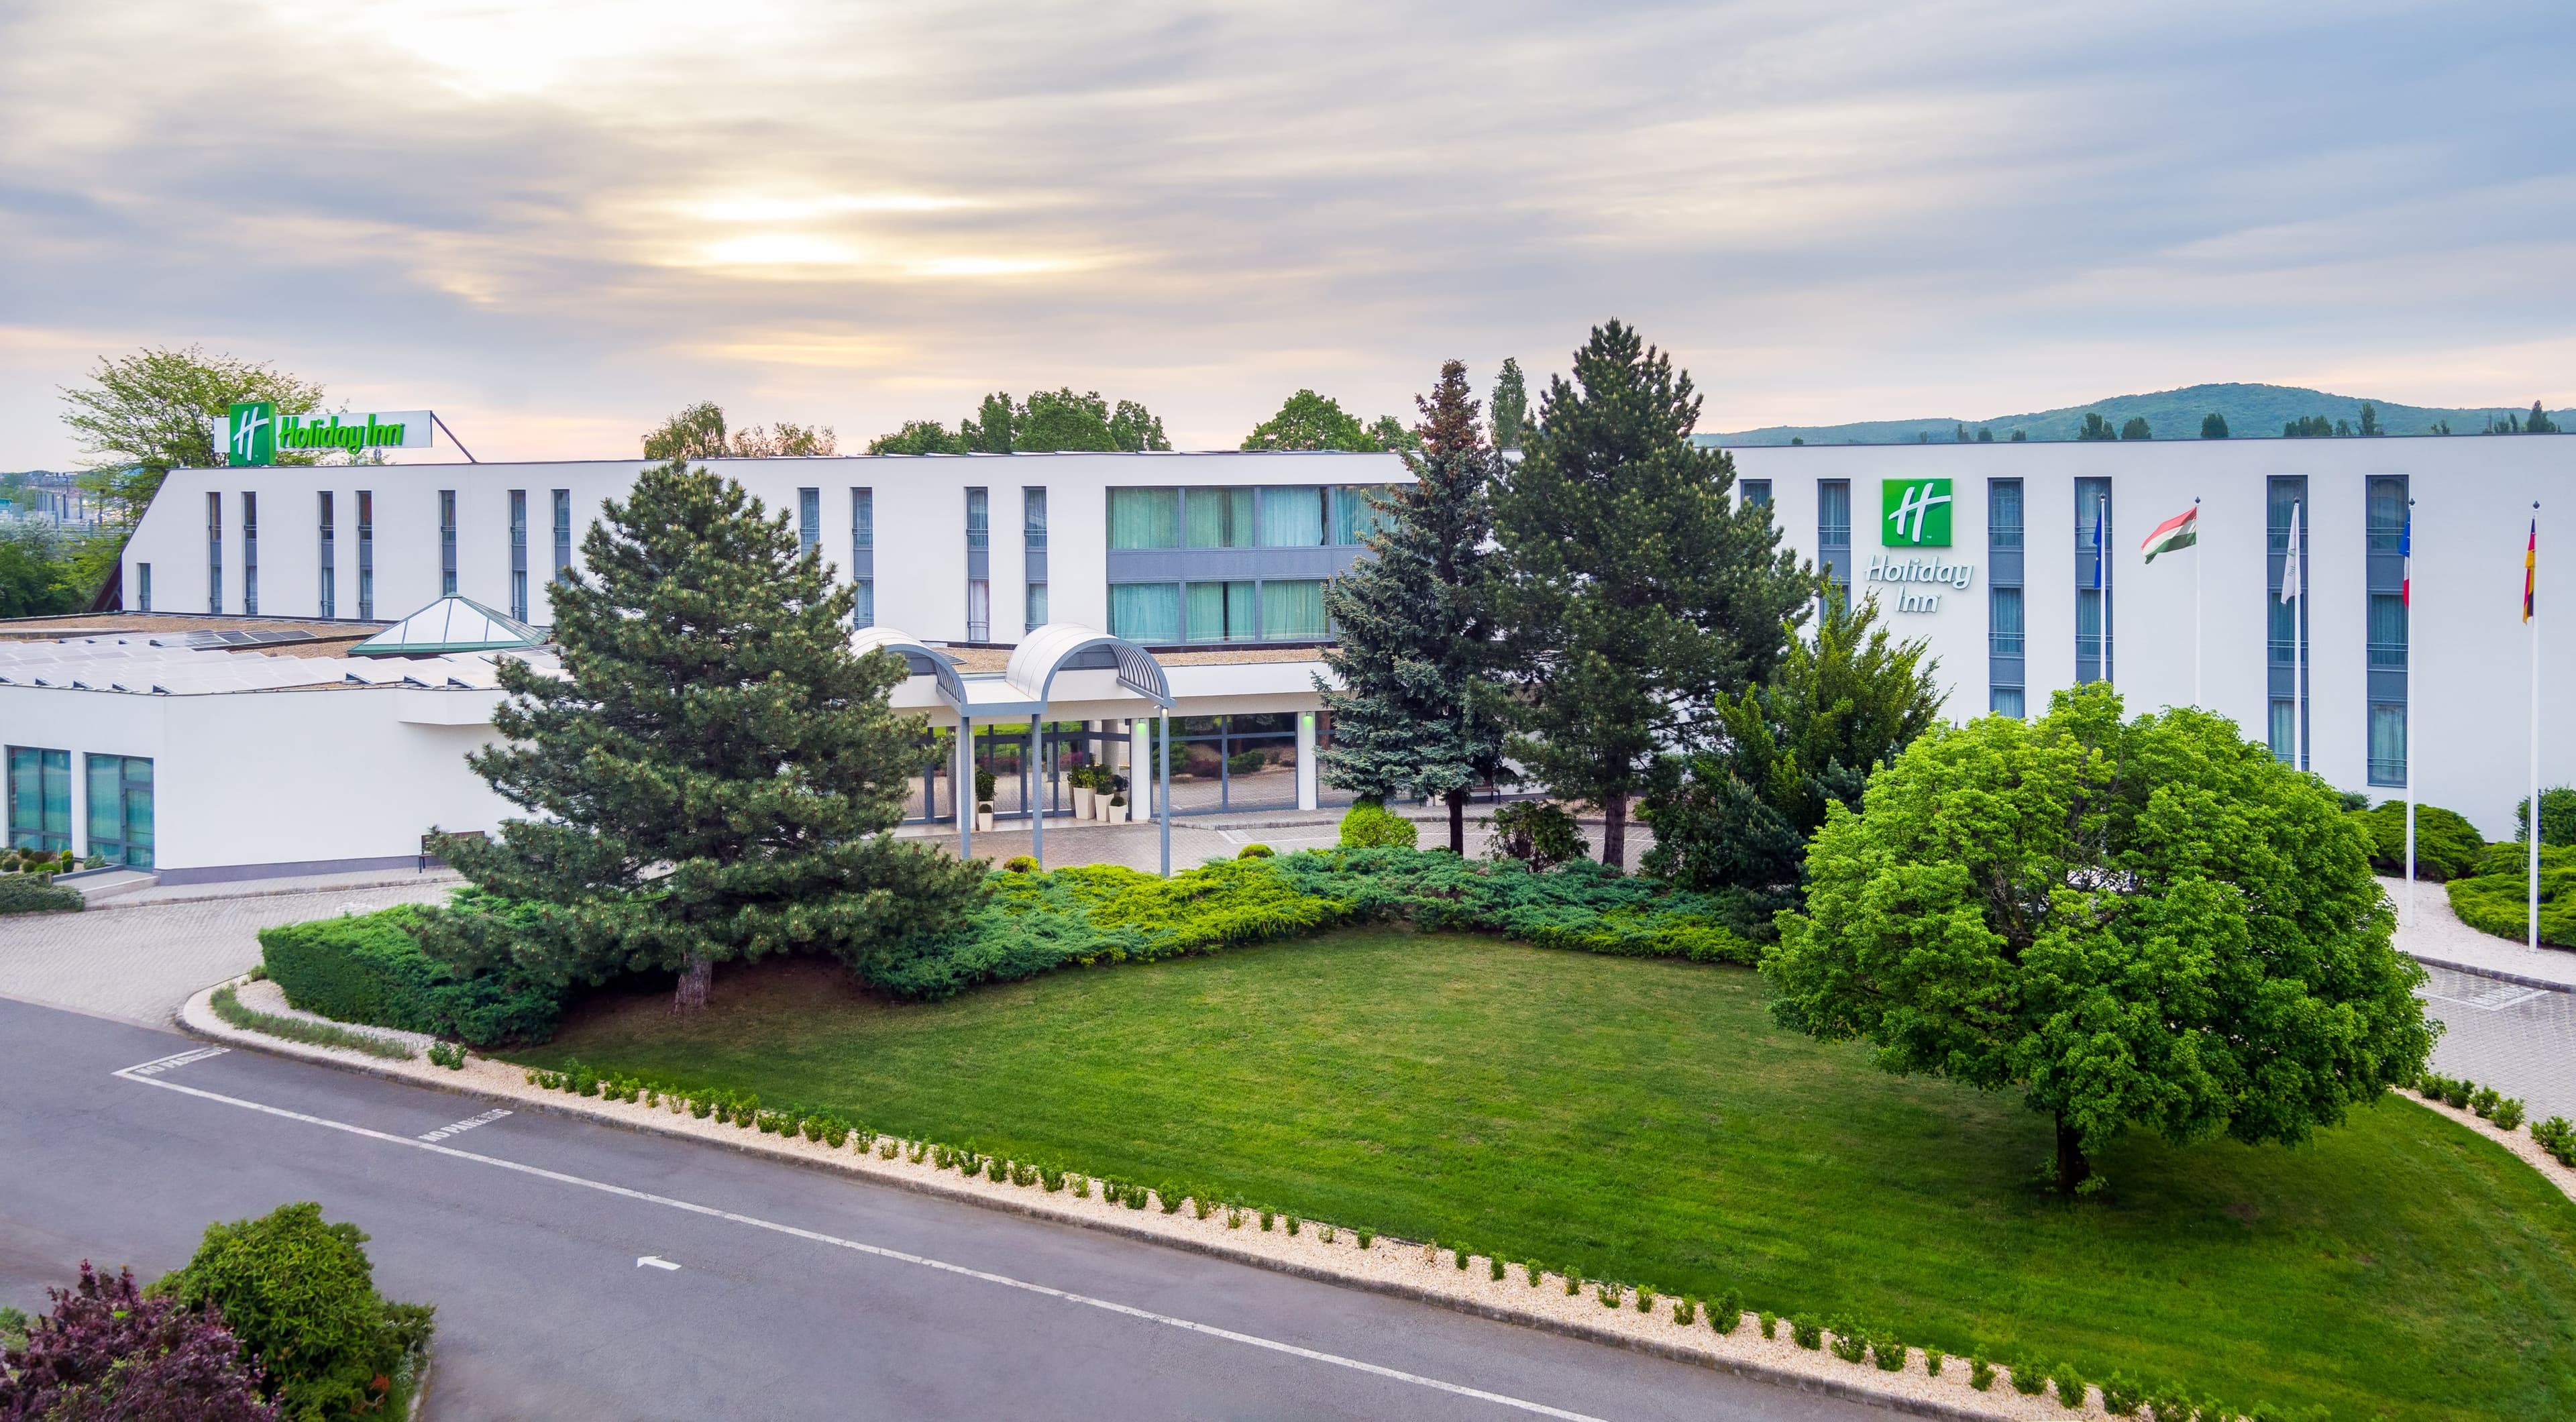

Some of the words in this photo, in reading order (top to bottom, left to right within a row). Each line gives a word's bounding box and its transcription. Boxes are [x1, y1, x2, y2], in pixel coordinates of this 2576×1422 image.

[279, 416, 366, 455] Holiday
[365, 414, 405, 446] Inn
[1888, 482, 1951, 542] H
[1865, 554, 1974, 590] Holiday
[1896, 585, 1941, 612] Inn
[418, 1131, 451, 1142] NO
